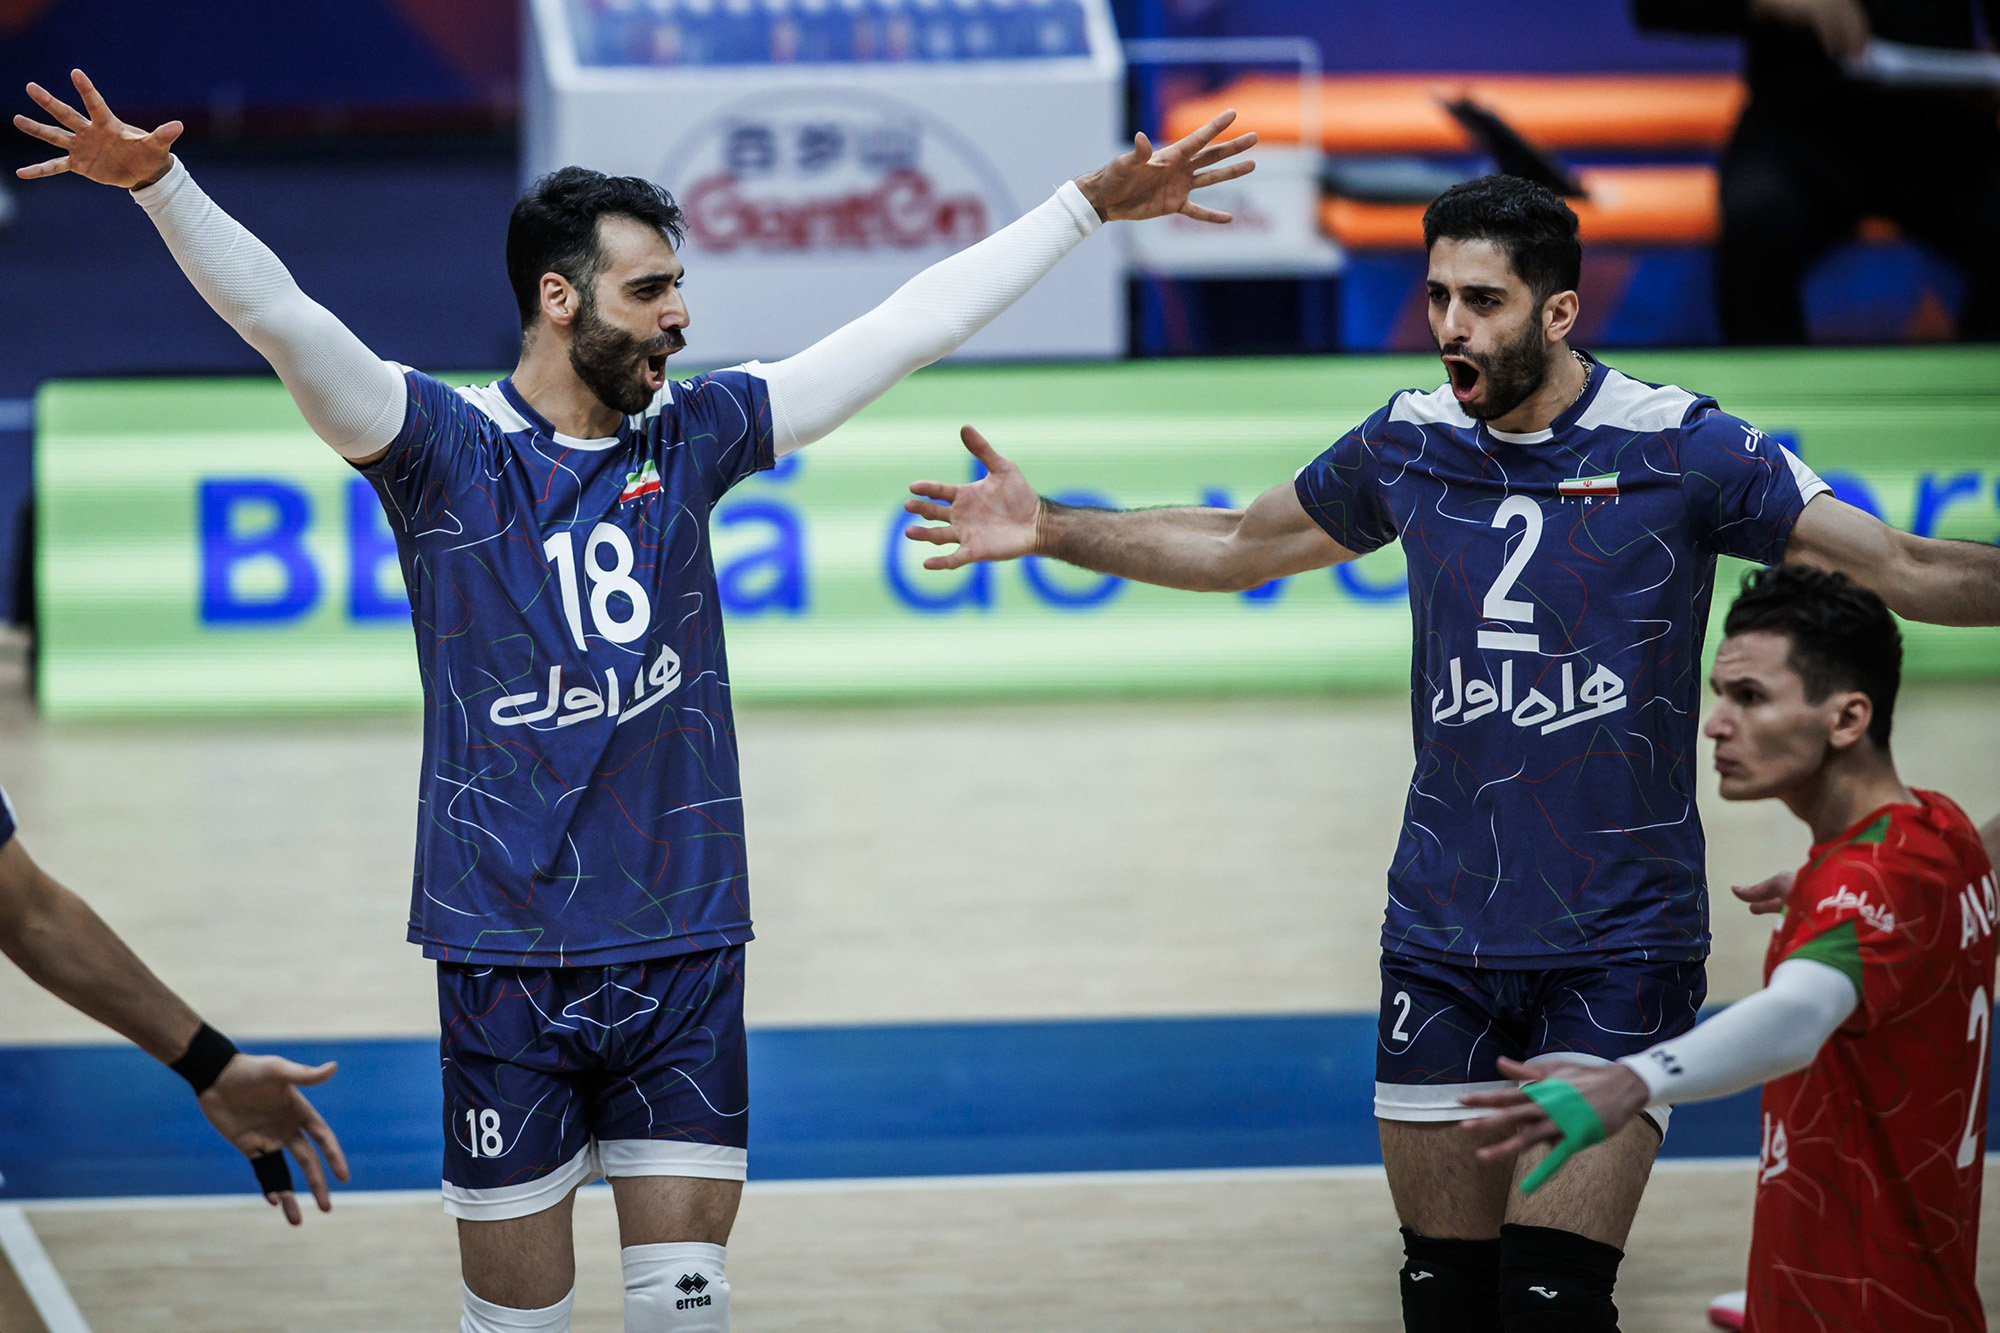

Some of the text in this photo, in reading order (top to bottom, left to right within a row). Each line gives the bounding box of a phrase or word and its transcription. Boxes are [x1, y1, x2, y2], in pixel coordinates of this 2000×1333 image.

[543, 521, 651, 652] 18
[1482, 494, 1543, 623] 2
[1391, 990, 1412, 1042] 2
[465, 1108, 504, 1158] 18
